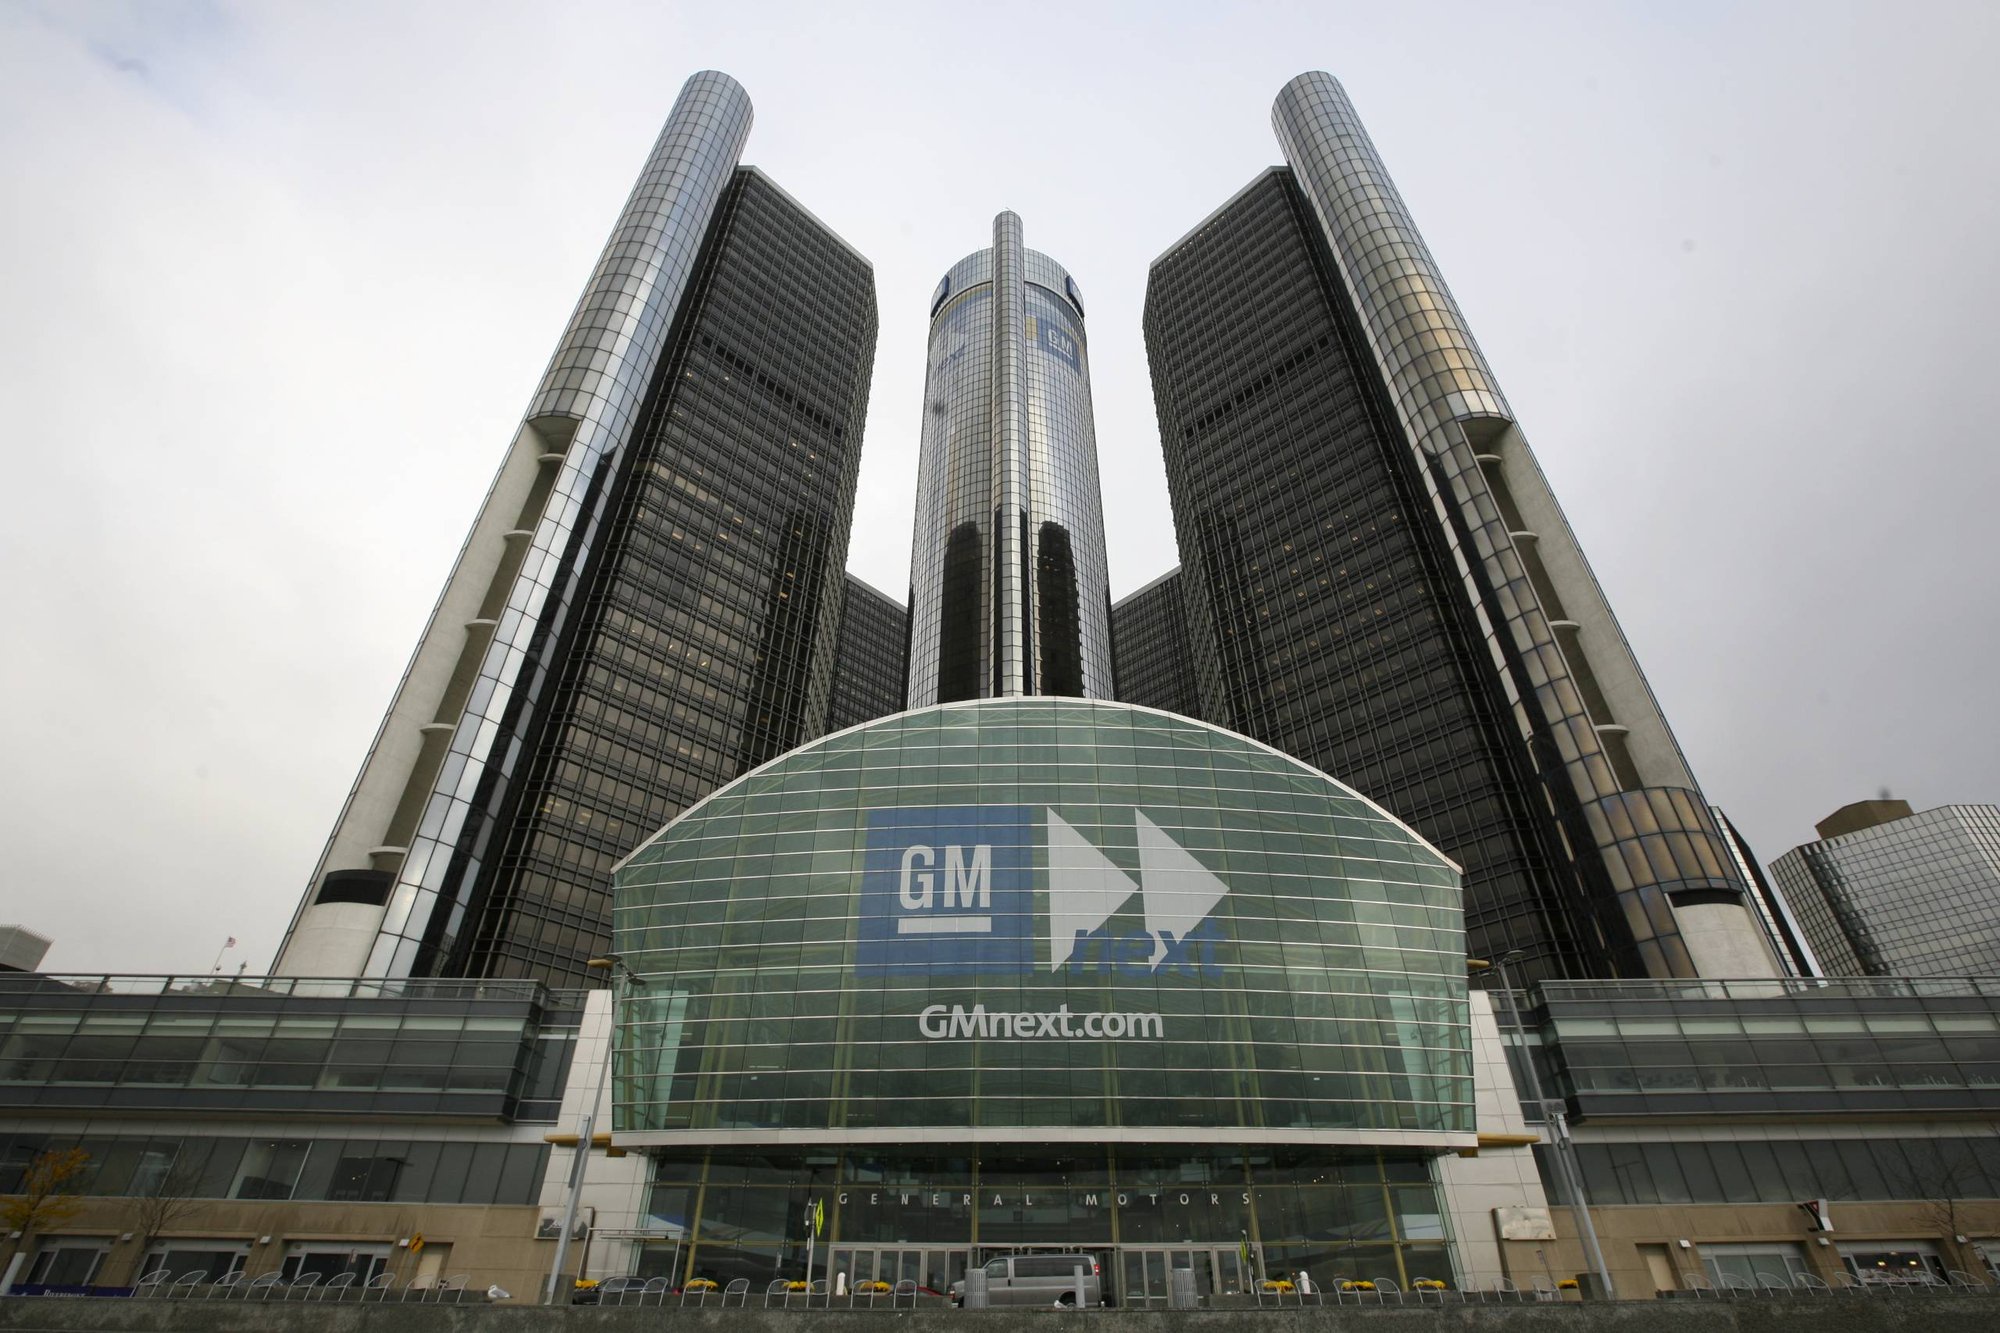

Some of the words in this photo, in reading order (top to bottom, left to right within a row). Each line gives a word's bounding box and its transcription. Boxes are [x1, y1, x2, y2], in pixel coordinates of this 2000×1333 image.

[899, 844, 992, 910] GM
[1070, 919, 1226, 978] next
[918, 1003, 1165, 1038] GMnext.com
[838, 1193, 1033, 1206] GENERAL
[1085, 1193, 1250, 1206] MOTORS
